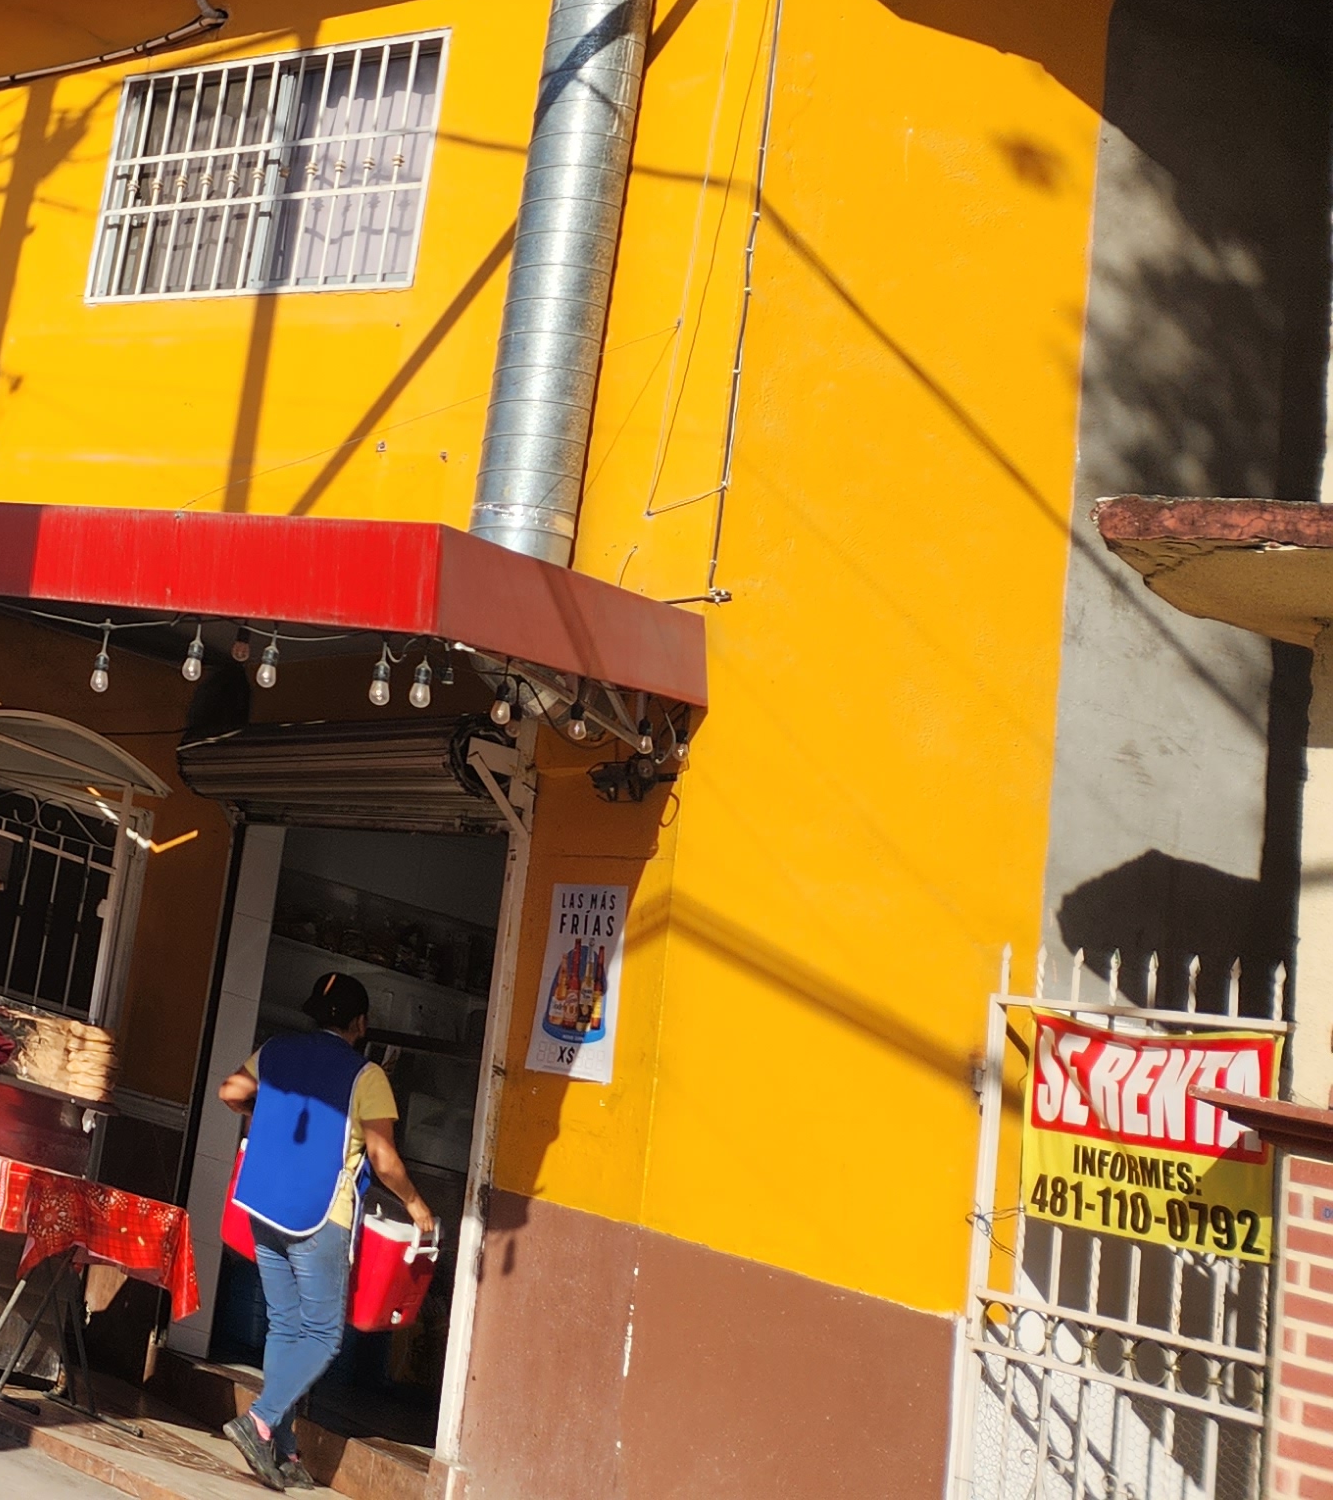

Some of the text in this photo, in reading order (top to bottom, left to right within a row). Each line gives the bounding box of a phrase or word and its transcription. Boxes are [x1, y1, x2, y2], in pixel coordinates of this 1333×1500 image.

[559, 910, 615, 937] FRÍAS
[561, 891, 617, 911] LAS MÁS
[1036, 1024, 1263, 1153] SE RENTA
[1073, 1144, 1203, 1196] INFORMES:
[1030, 1173, 1265, 1256] 481-110-0792
